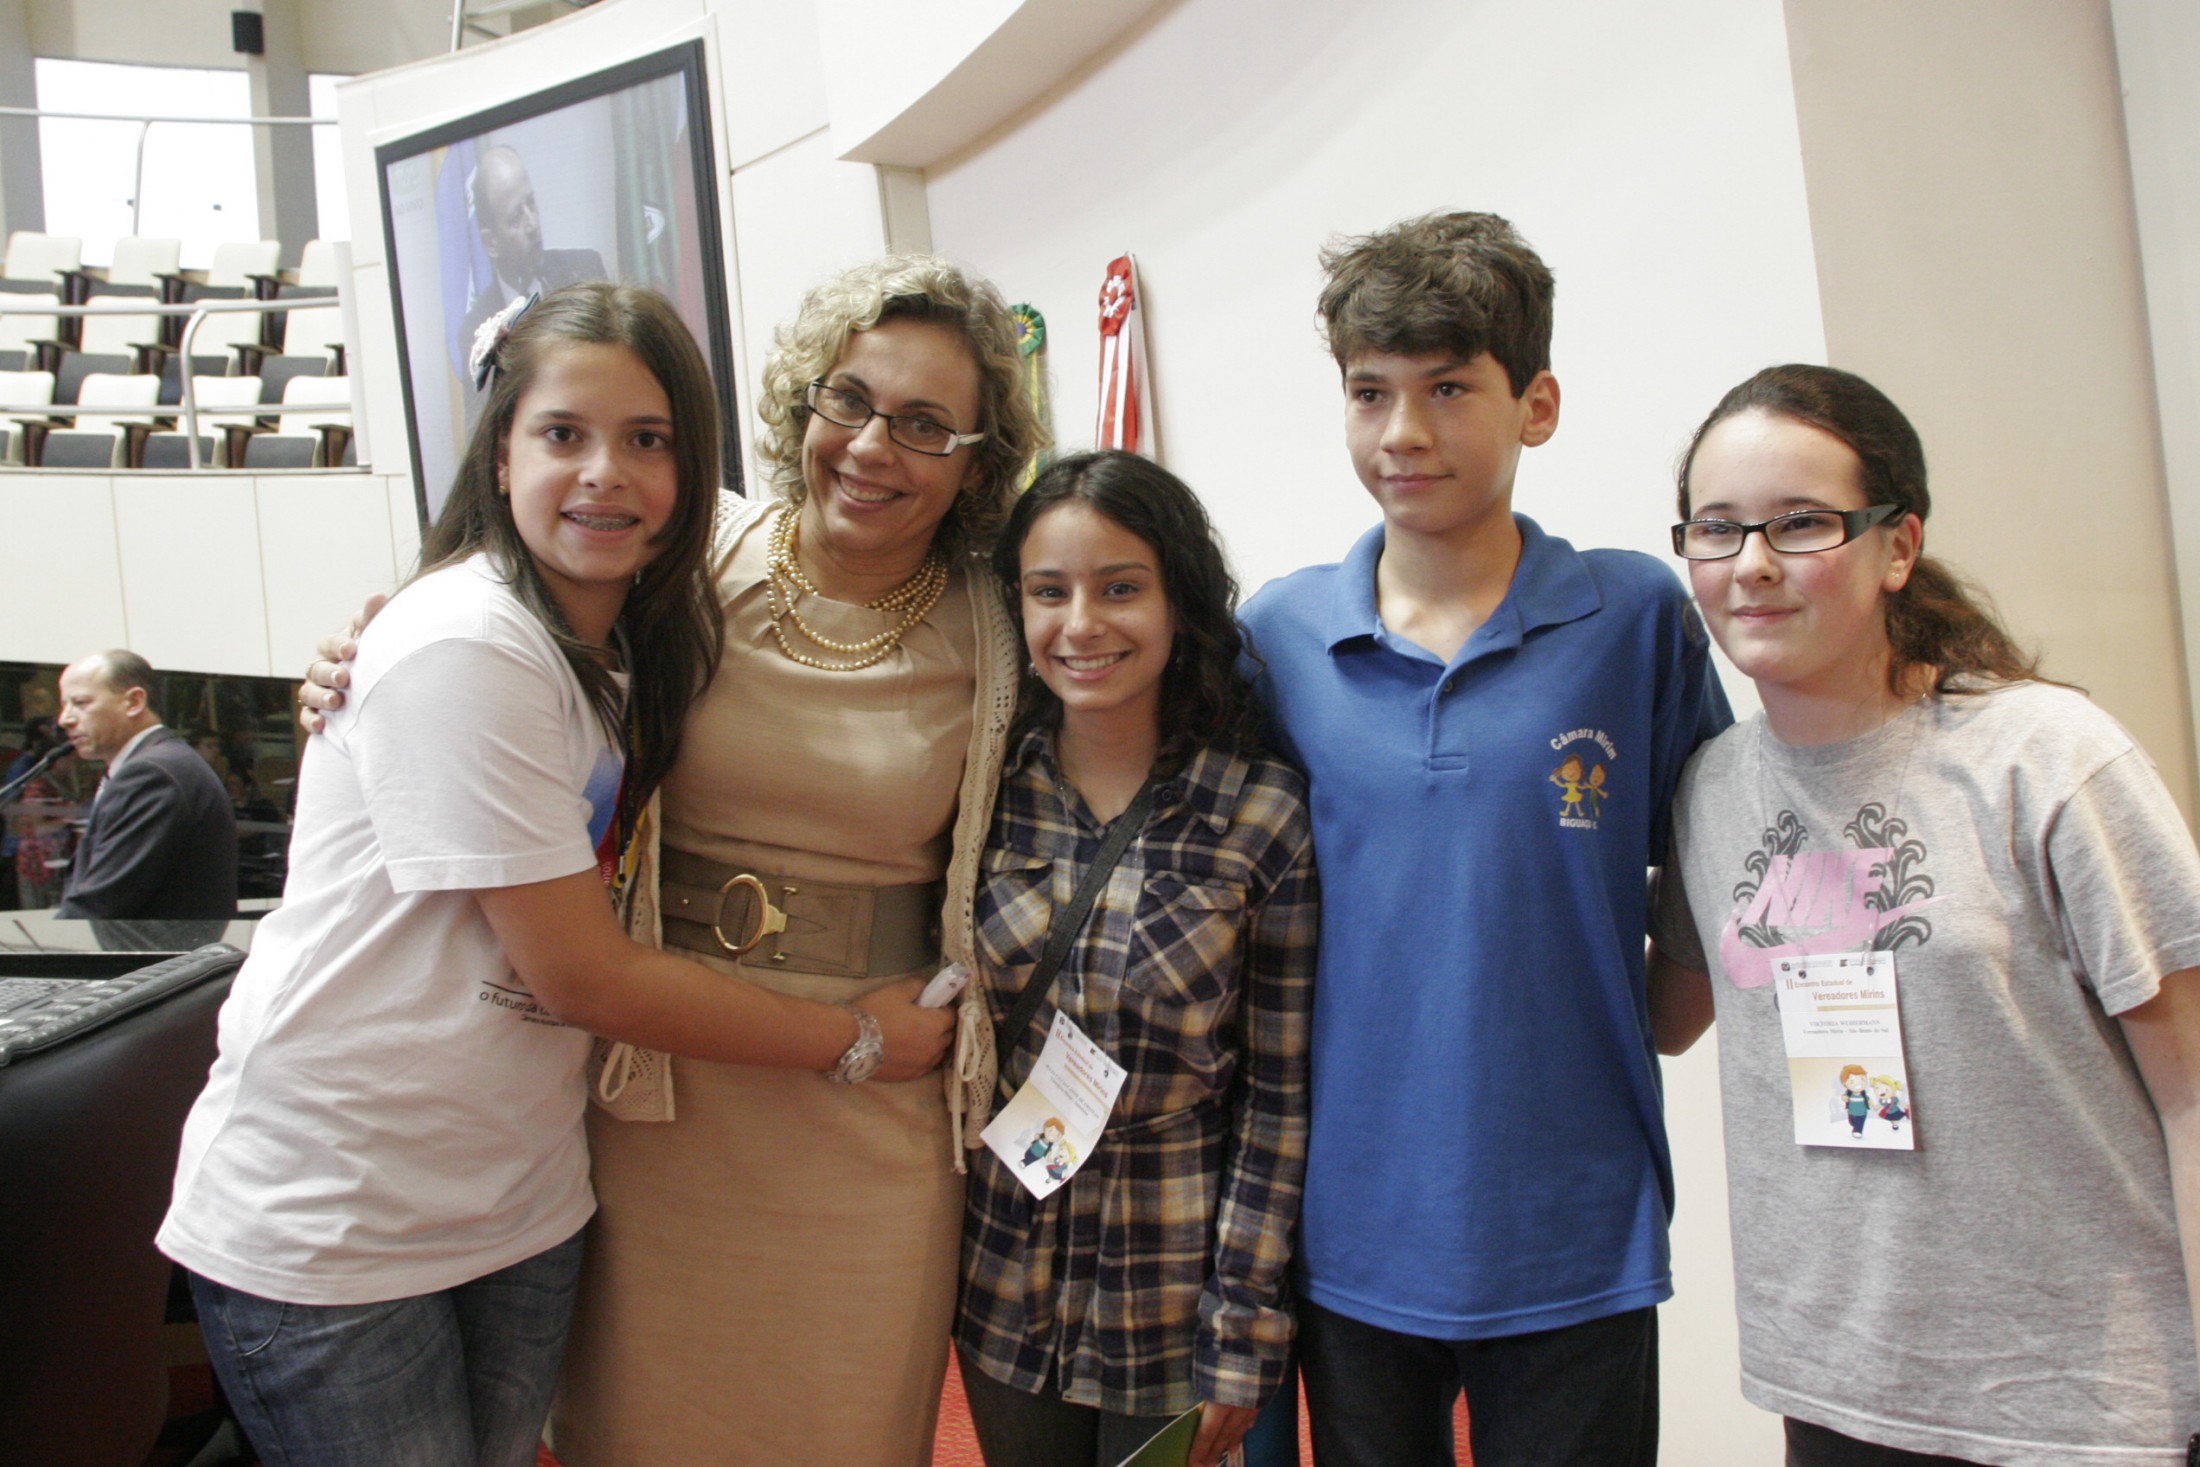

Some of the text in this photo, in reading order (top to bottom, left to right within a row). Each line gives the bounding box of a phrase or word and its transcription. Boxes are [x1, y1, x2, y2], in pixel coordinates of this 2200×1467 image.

[1739, 847, 1896, 927] NIKE
[1812, 988, 1885, 1001] Vereadores Mirins
